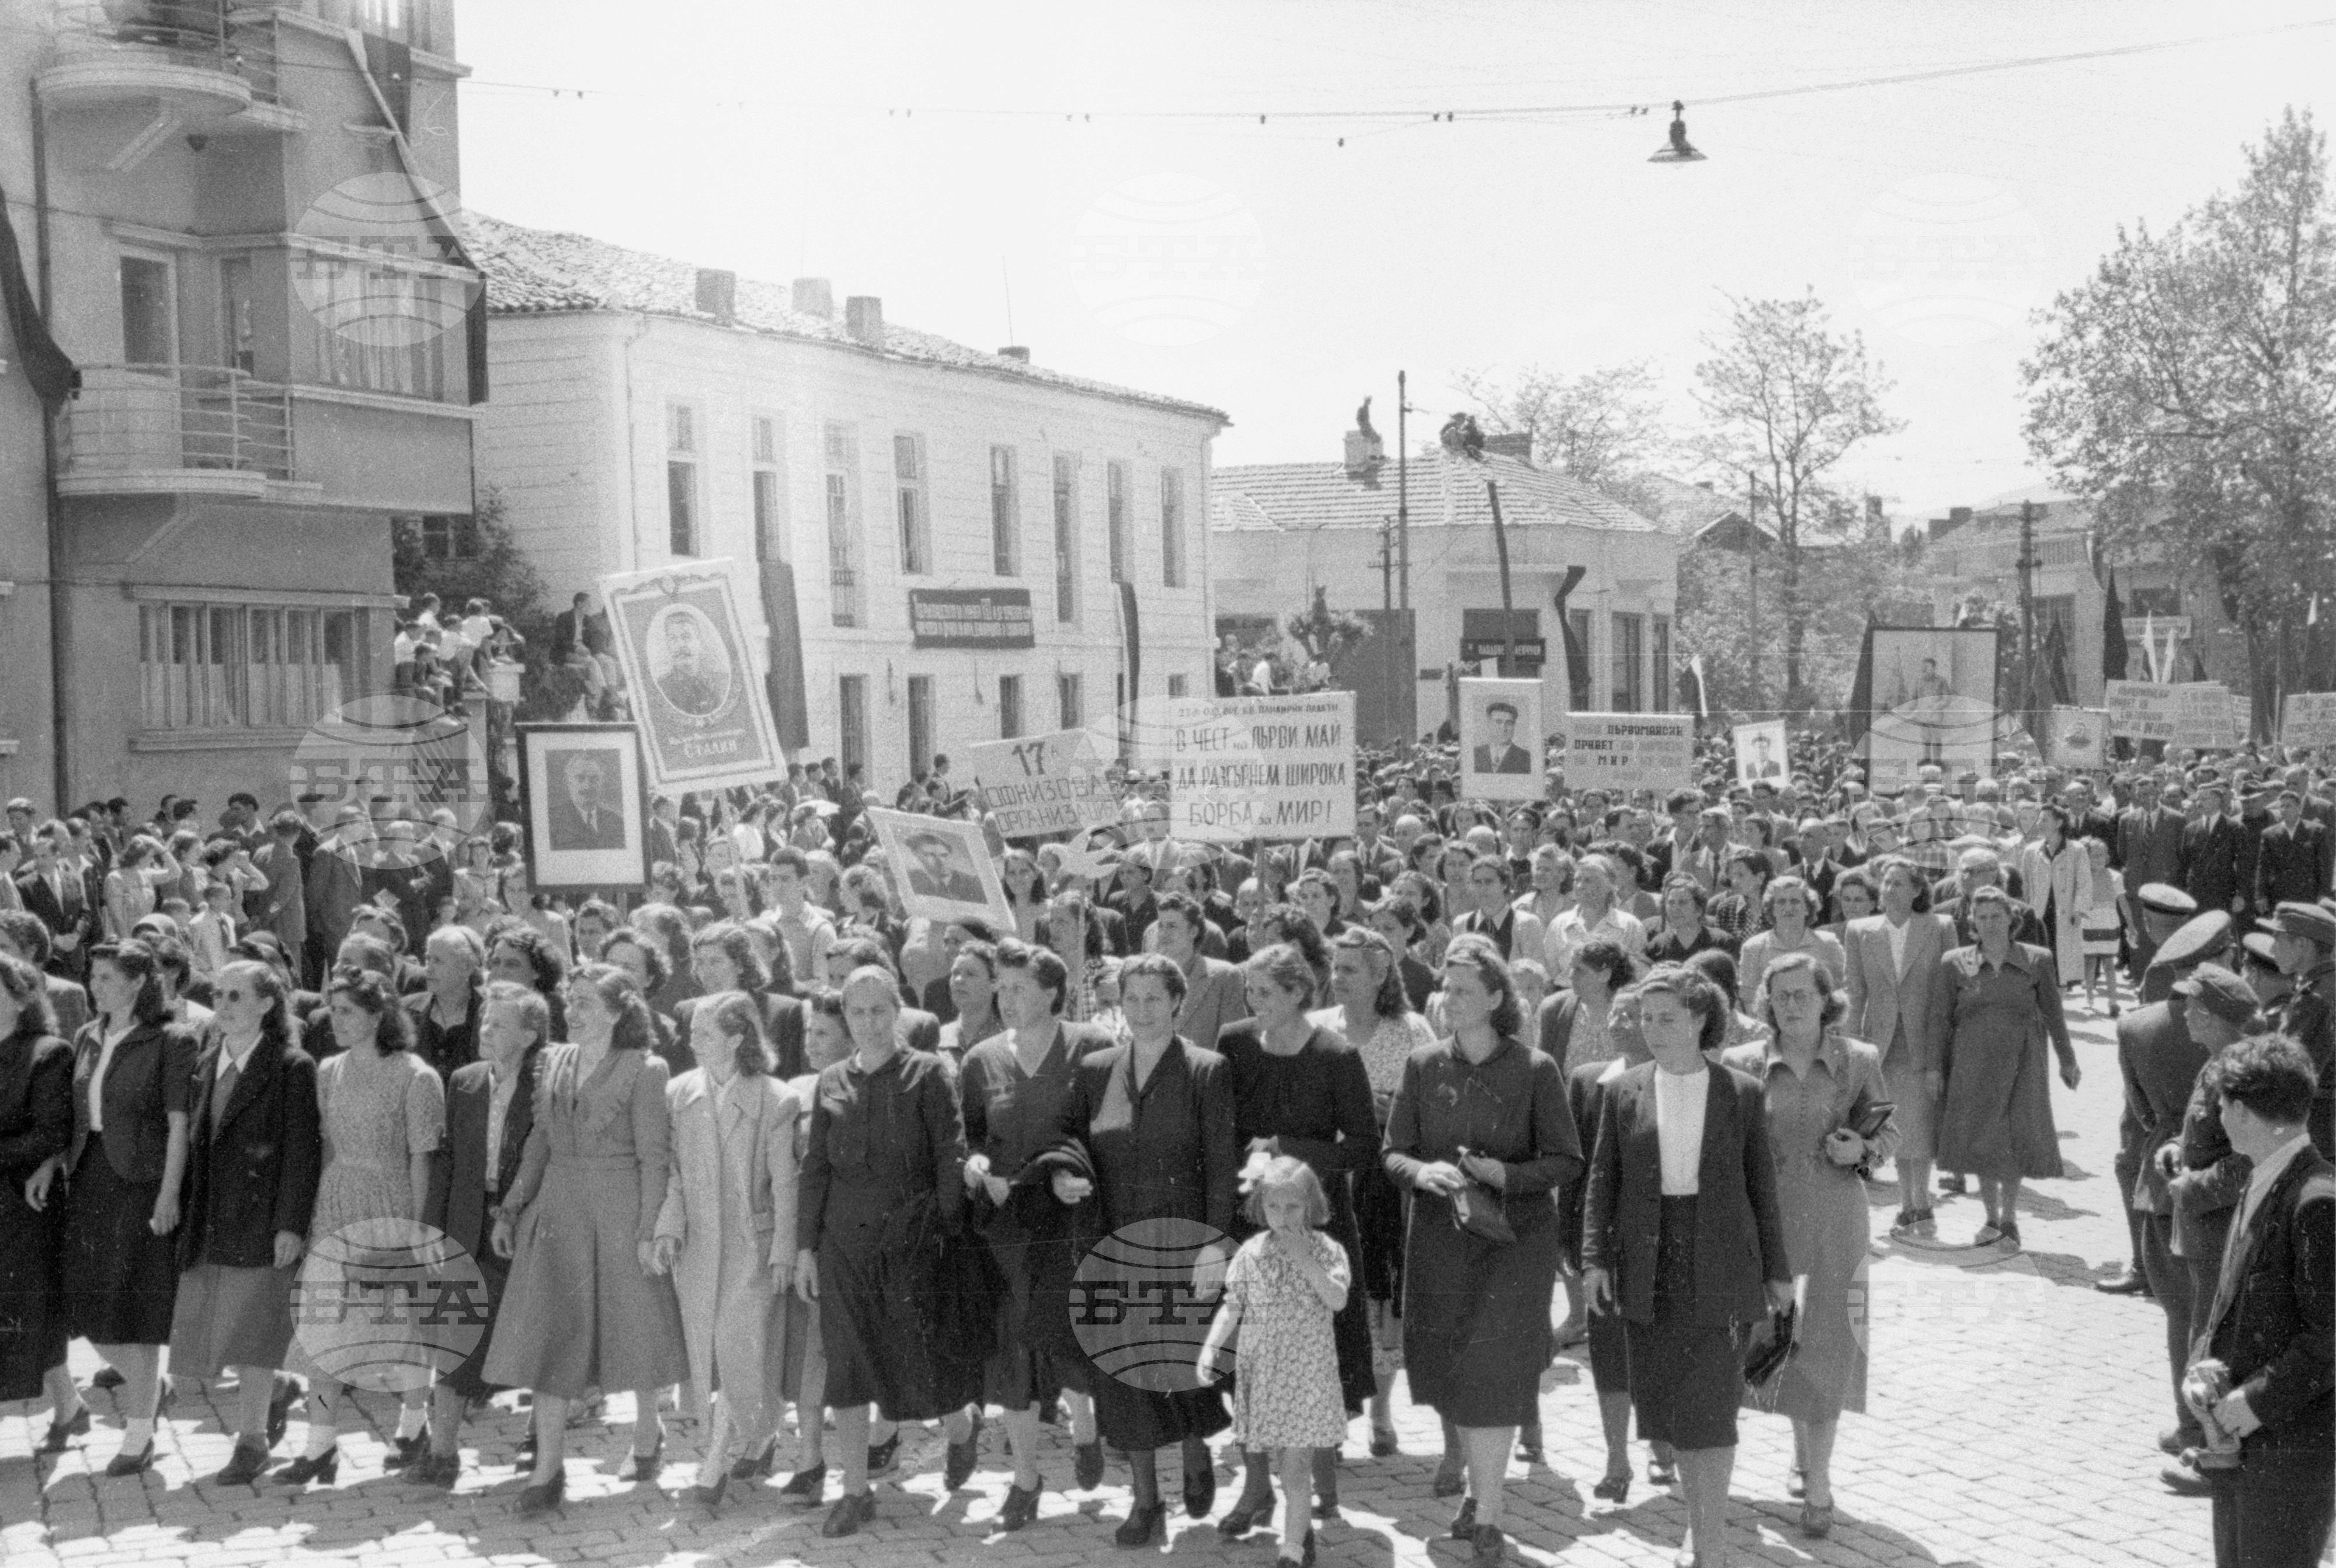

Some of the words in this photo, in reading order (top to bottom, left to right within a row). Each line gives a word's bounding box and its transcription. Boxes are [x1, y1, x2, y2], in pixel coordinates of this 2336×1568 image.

[1176, 728, 1187, 752] В
[1194, 726, 1230, 751] ЧЕСТ
[1305, 719, 1343, 746] МАЙ
[1573, 739, 1614, 750] ПРИВЕТ
[1011, 740, 1046, 777] 17
[1176, 766, 1197, 791] ДА
[1201, 763, 1280, 788] РАЗГЪРНЕМ
[1285, 762, 1346, 787] ШИРОКА
[1189, 801, 1254, 827] БОРБА
[1275, 799, 1332, 826] МИР!
